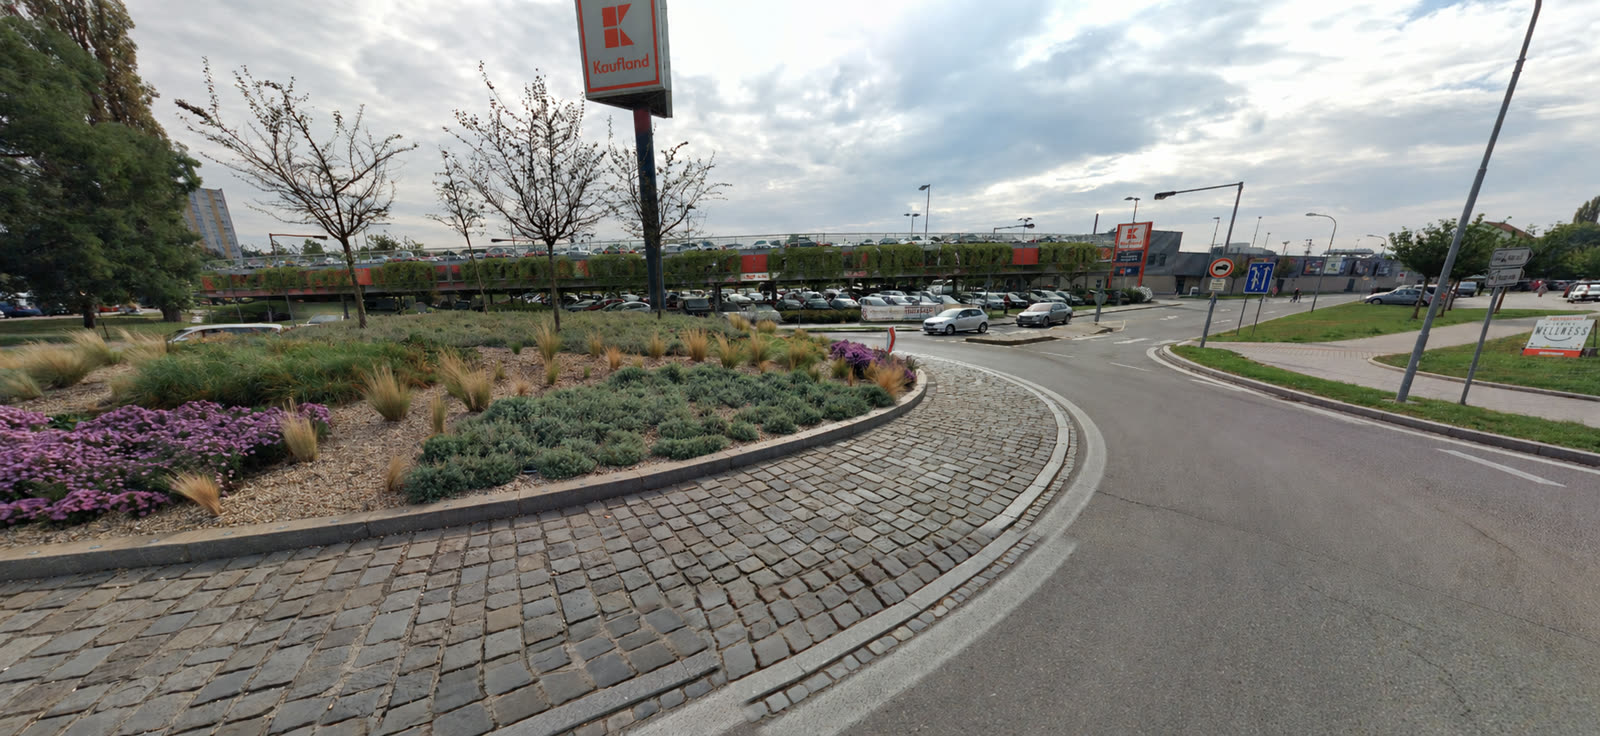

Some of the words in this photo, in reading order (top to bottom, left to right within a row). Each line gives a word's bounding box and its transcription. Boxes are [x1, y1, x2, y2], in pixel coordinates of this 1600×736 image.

[602, 4, 635, 49] K
[592, 53, 650, 75] Kaufland
[1535, 326, 1589, 336] WELLNESS
